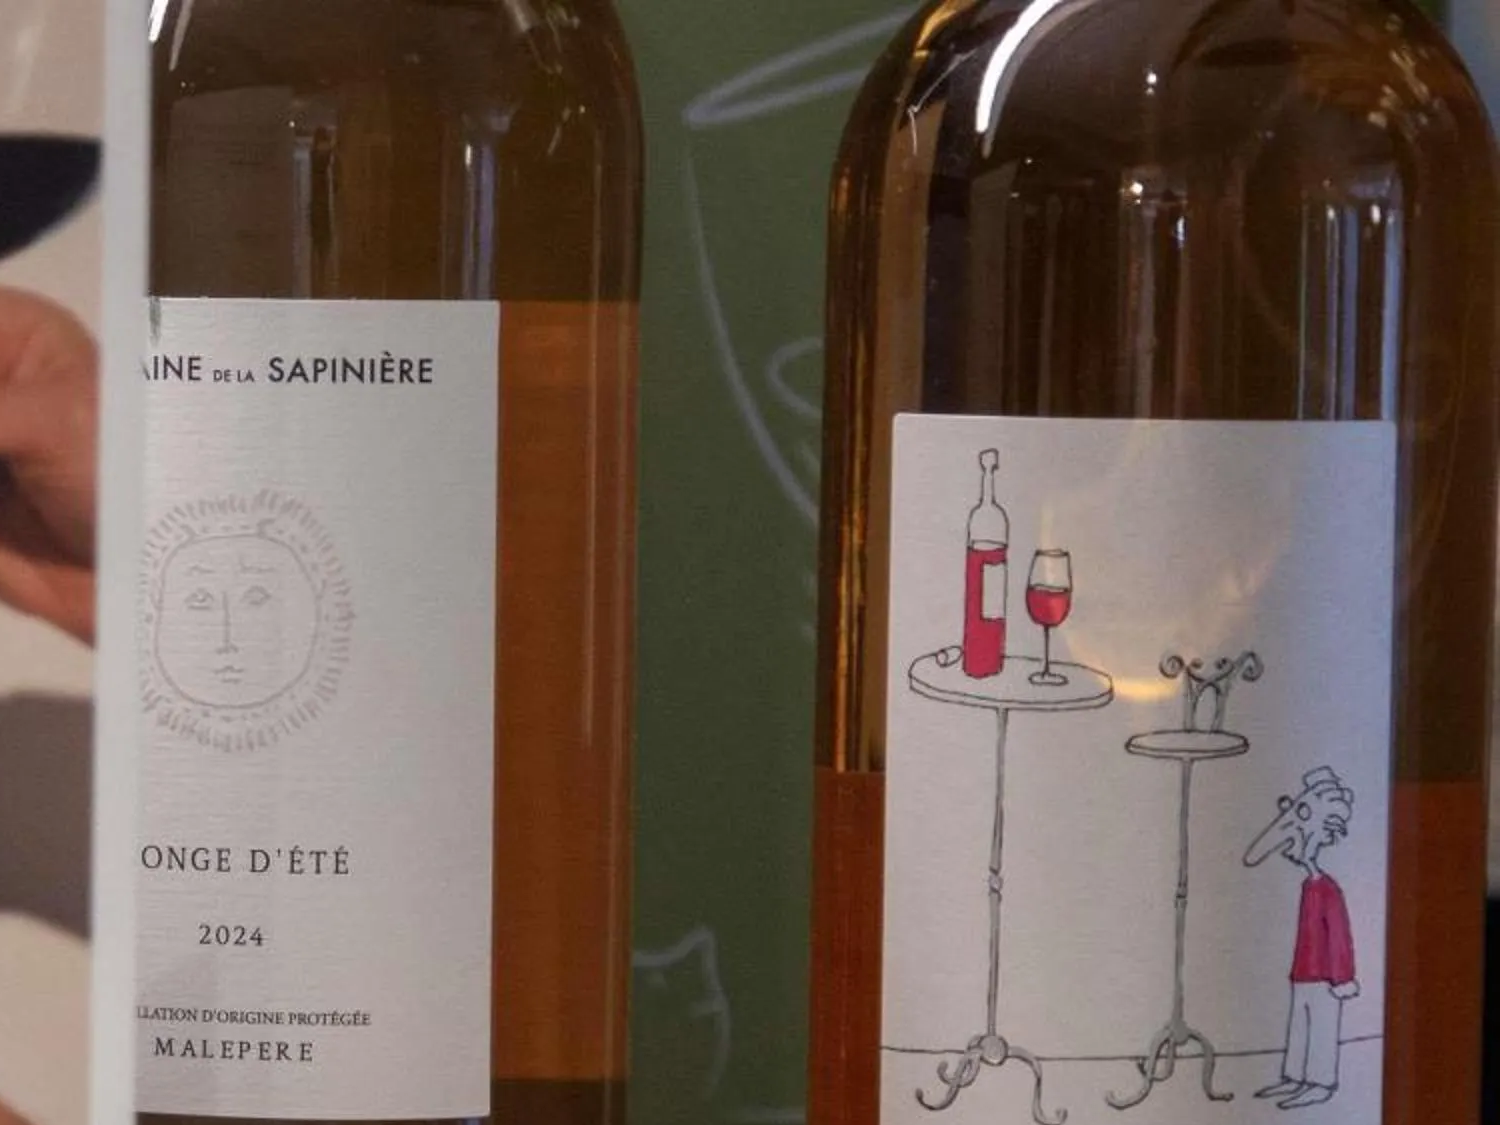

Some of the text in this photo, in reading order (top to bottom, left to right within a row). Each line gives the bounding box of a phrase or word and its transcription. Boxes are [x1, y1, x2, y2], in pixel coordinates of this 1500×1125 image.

[213, 369, 232, 383] DE
[237, 369, 255, 383] LA
[268, 351, 434, 385] SAPINIÈRE
[140, 845, 350, 875] ONGE D'ÉTÉ
[198, 925, 265, 947] 2024
[202, 1009, 285, 1026] D'ORIGINE
[289, 1010, 372, 1027] PROTÉGÉE
[153, 1036, 314, 1063] MALEPERE
